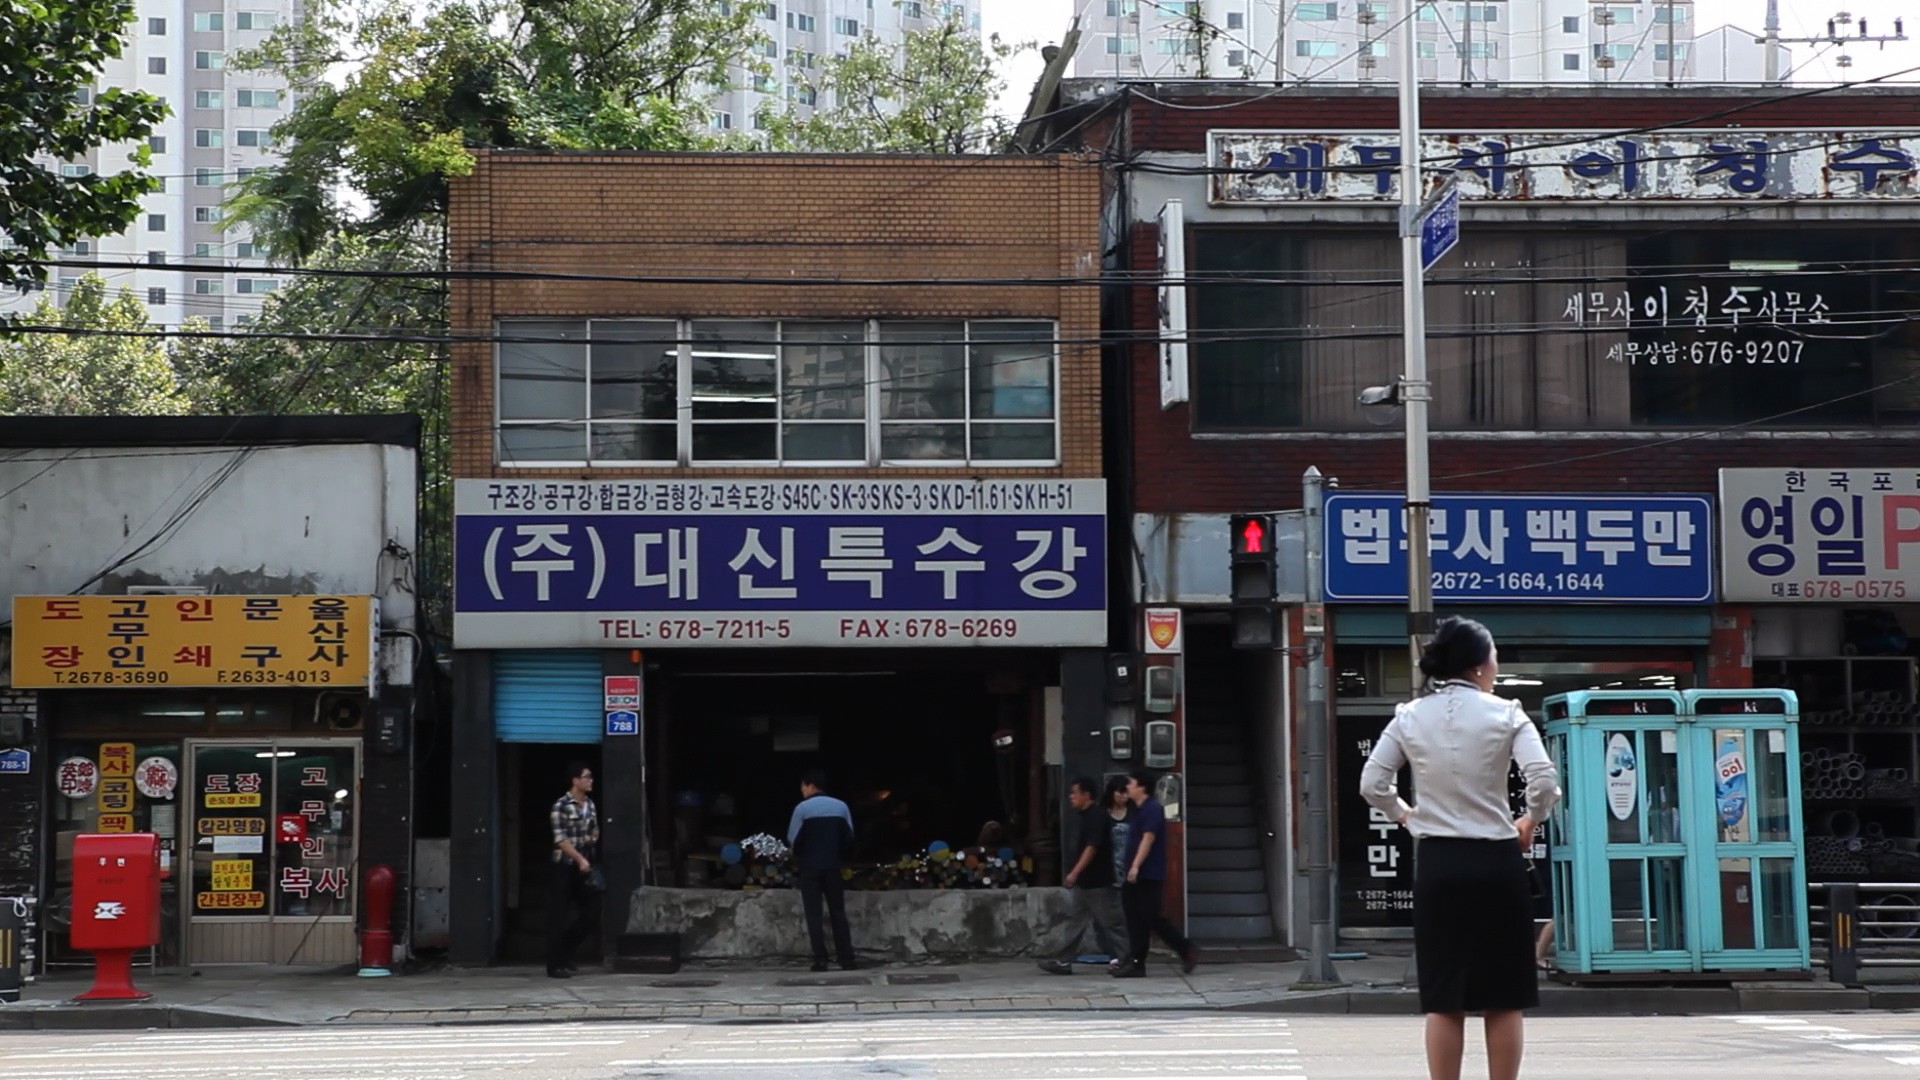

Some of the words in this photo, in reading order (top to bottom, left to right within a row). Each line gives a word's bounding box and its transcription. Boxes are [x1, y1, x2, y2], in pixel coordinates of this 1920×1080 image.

[1526, 510, 1696, 566] 백두만
[1804, 580, 1906, 599] 678-0575
[613, 721, 633, 731] 788
[205, 773, 261, 793] 도장
[281, 868, 348, 898] 복사
[200, 893, 262, 907] 간편장부
